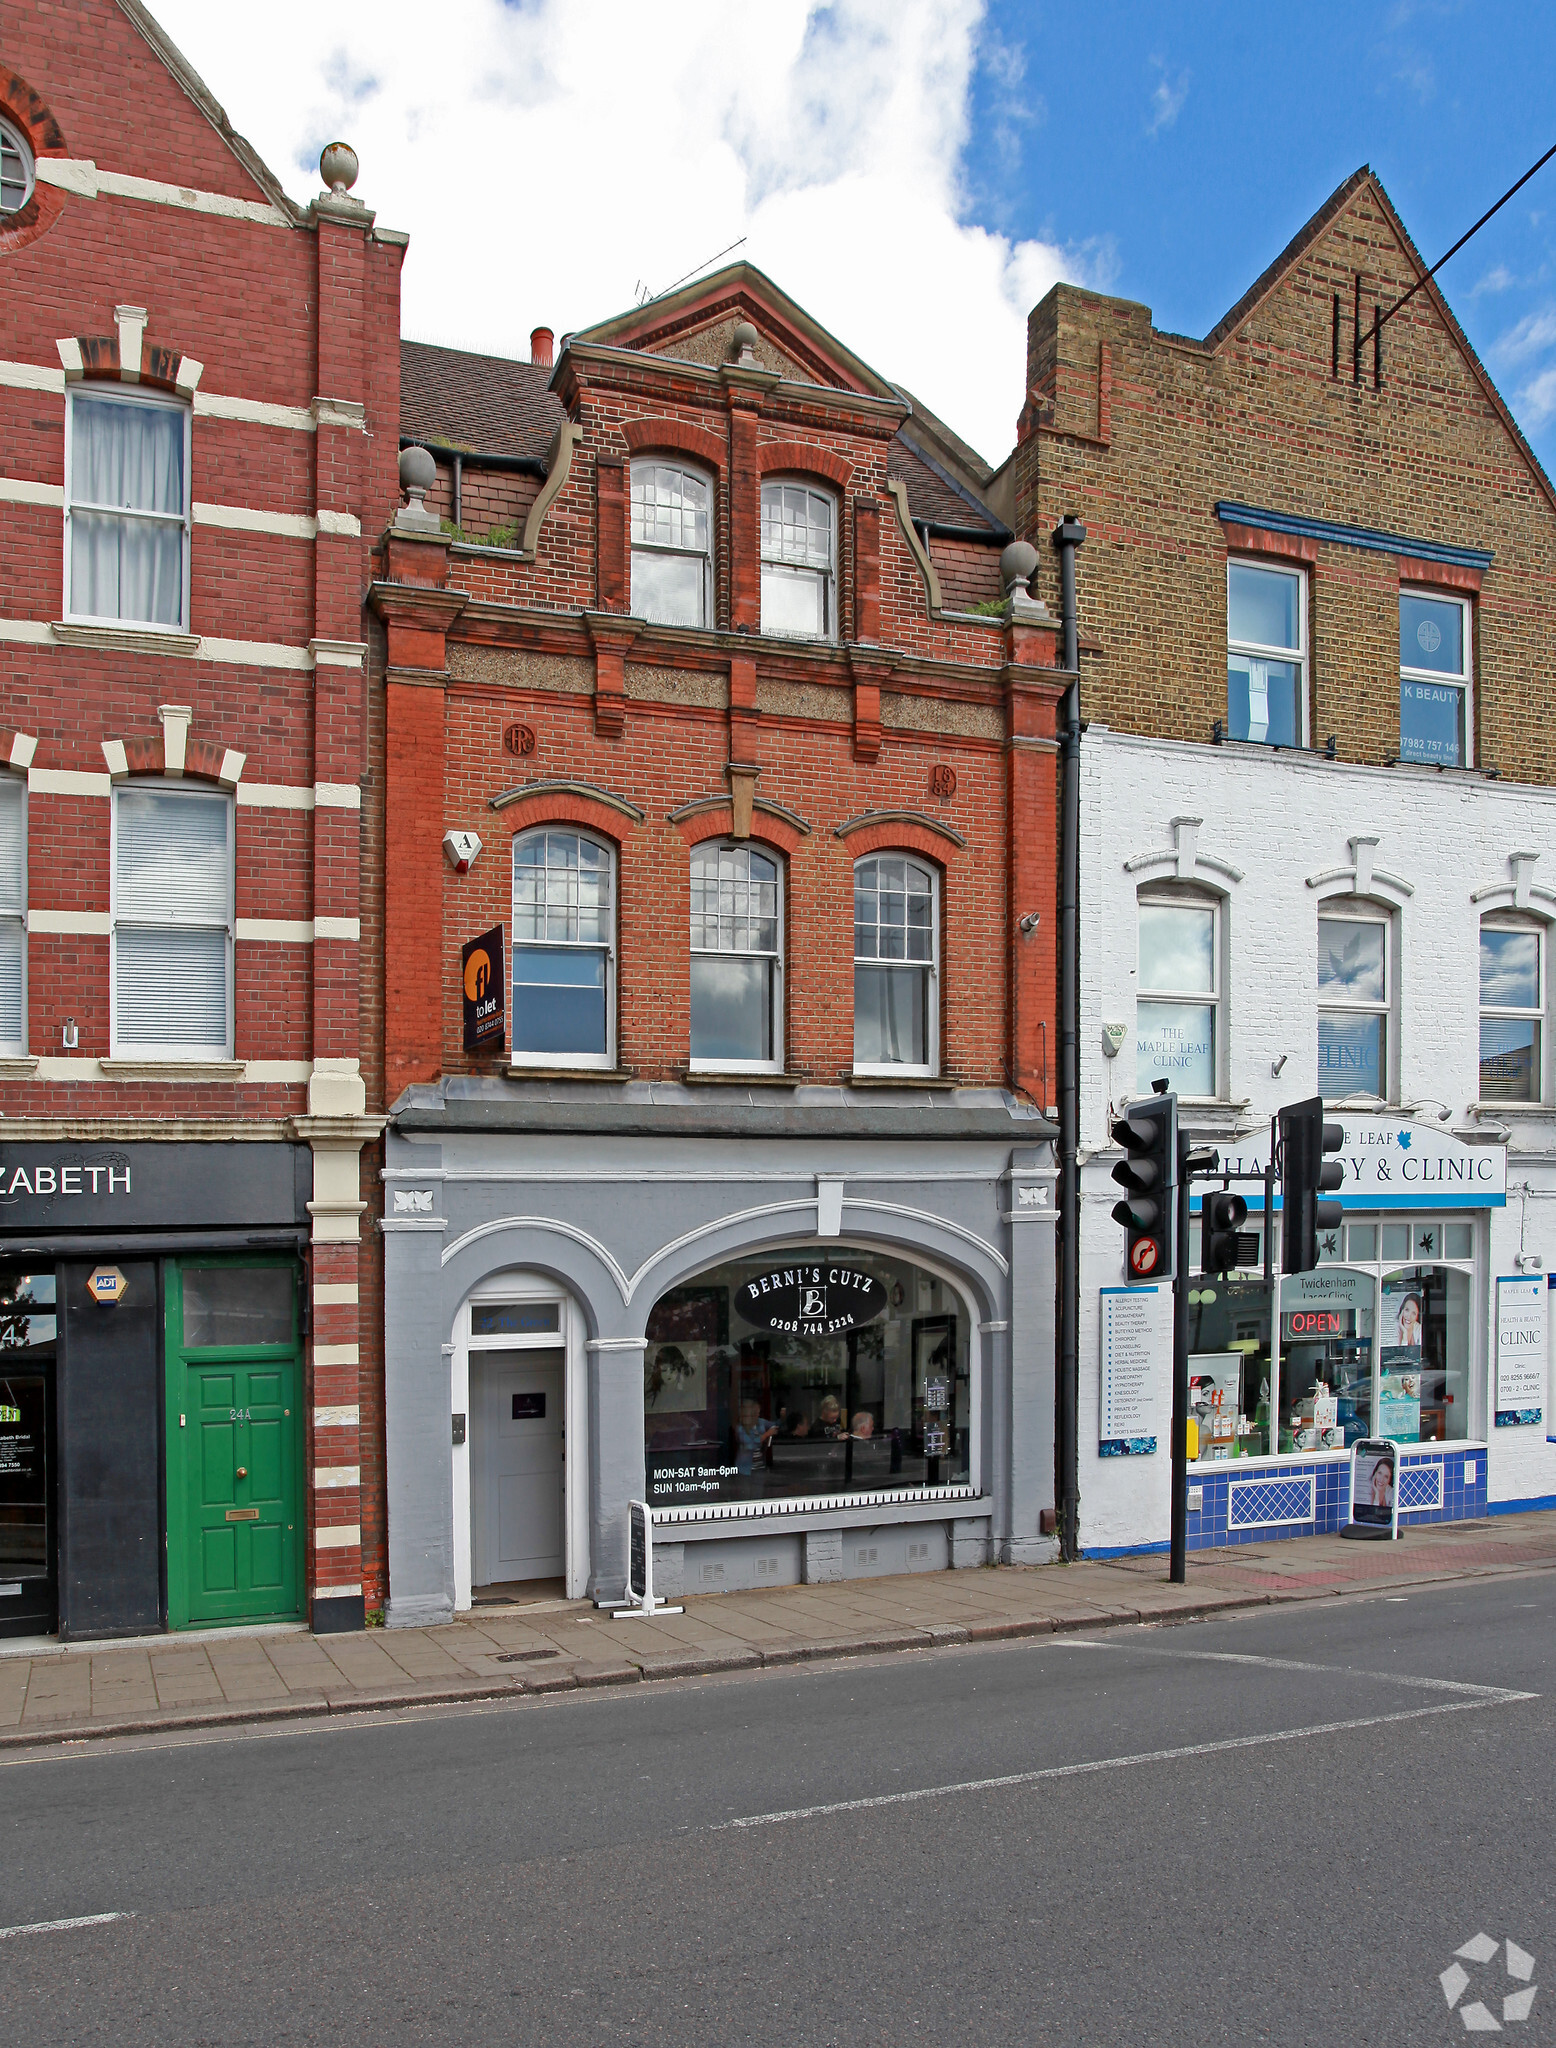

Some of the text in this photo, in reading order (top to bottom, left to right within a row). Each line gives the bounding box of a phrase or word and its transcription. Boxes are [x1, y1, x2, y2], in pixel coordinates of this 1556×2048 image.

[1416, 687, 1461, 704] BEAUTY
[1427, 740, 1442, 751] 757
[1161, 1027, 1184, 1039] THE
[1137, 1040, 1209, 1054] MAPLE LEAF
[1153, 1055, 1193, 1067] CLINIC
[1359, 1131, 1394, 1145] LEAF
[1377, 1158, 1392, 1181] &
[1402, 1157, 1493, 1182] CLINIC
[96, 1278, 117, 1288] ADT
[747, 1267, 873, 1299] BERNI'S CUTZ
[1300, 1277, 1356, 1289] Twickenham
[802, 1290, 824, 1315] B
[499, 1315, 518, 1328] The
[770, 1317, 798, 1332] 0208
[803, 1322, 823, 1335] 744
[1292, 1313, 1340, 1332] OPEN
[1500, 1330, 1541, 1346] CLINIC
[229, 1408, 251, 1420] 24A
[653, 1465, 738, 1480] MON-SAT 9am-6pm
[653, 1481, 720, 1494] SUN 10am-4pm
